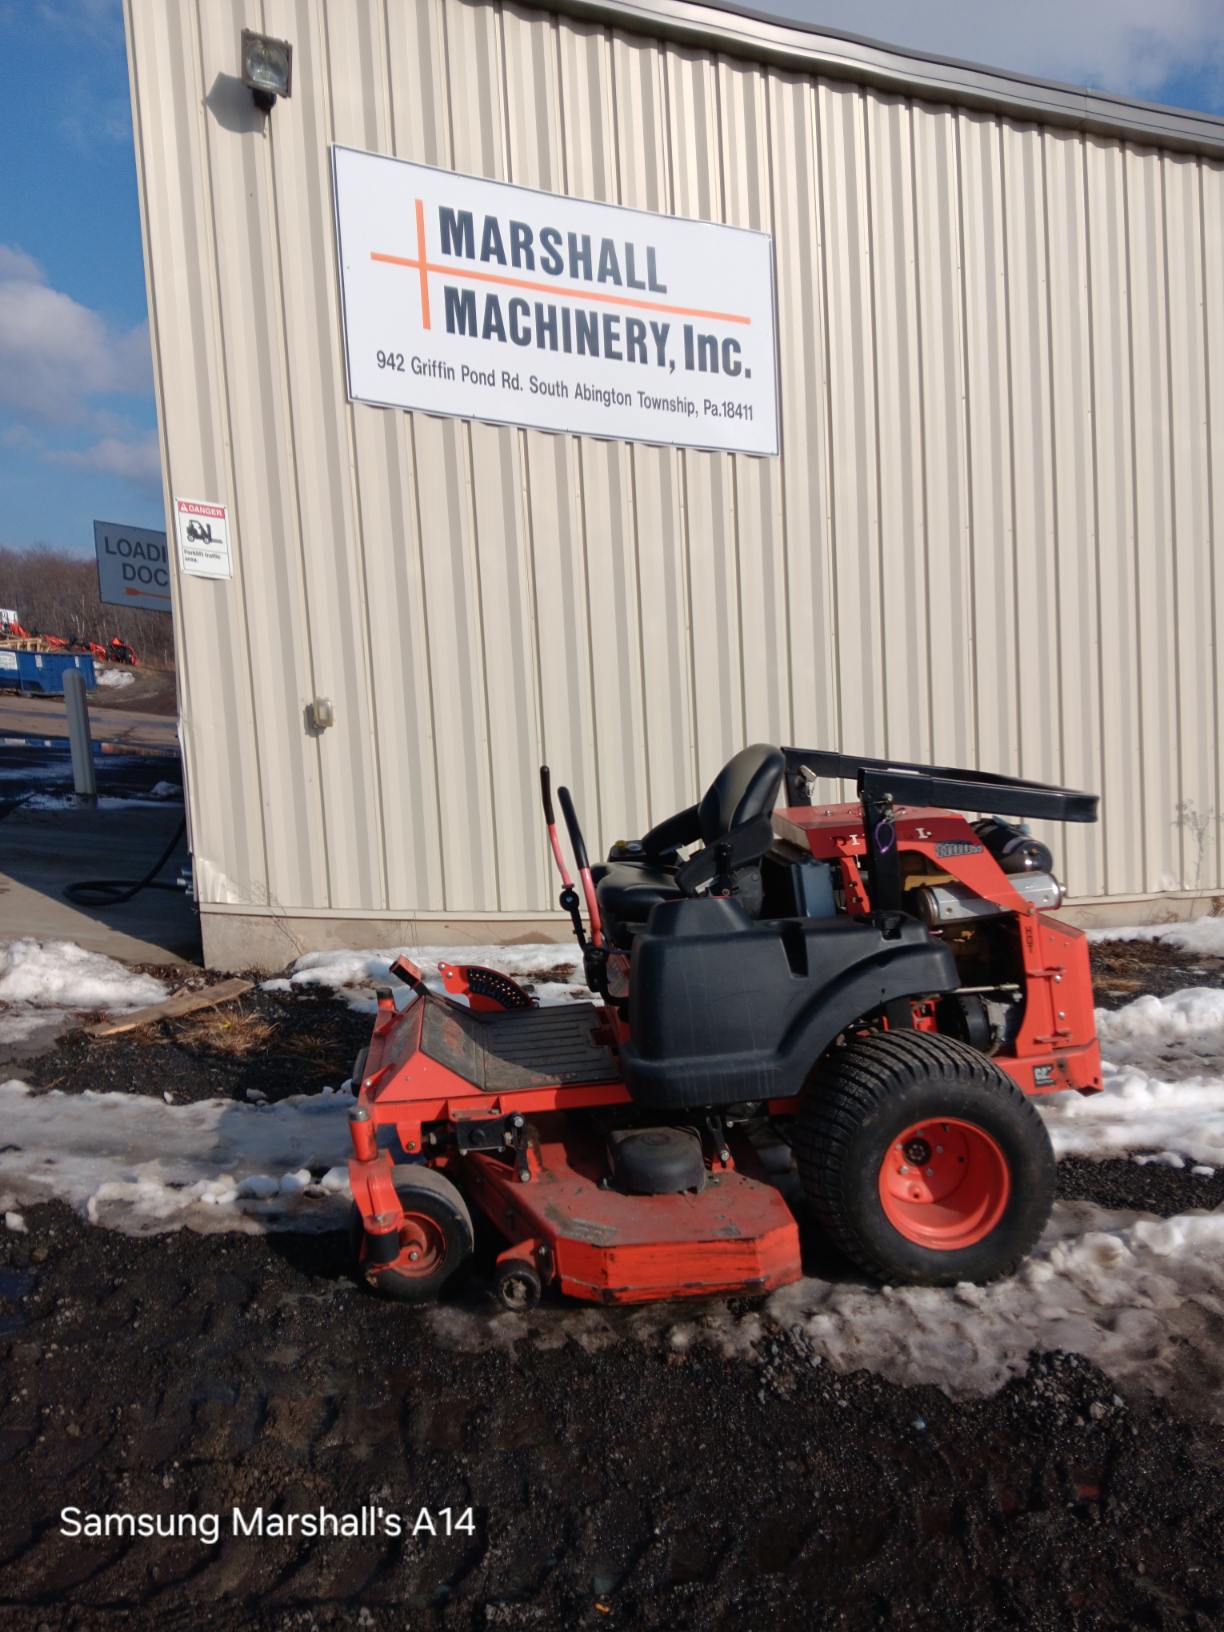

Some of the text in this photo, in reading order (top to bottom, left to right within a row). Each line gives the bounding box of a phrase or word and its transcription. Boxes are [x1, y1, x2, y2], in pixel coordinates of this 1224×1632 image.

[438, 205, 668, 295] MARSHALL
[443, 285, 752, 379] MACHINERY, Inc.
[376, 349, 406, 373] 942
[410, 355, 456, 381] Griffin
[460, 364, 496, 387] Pond
[501, 370, 524, 392] Rd.
[529, 375, 569, 399] South
[574, 382, 632, 408] Abington
[636, 390, 699, 418] Township,
[188, 504, 223, 517] DANGER
[104, 536, 167, 563] LOADI
[183, 548, 204, 558] Forklift
[121, 562, 169, 587] DOC
